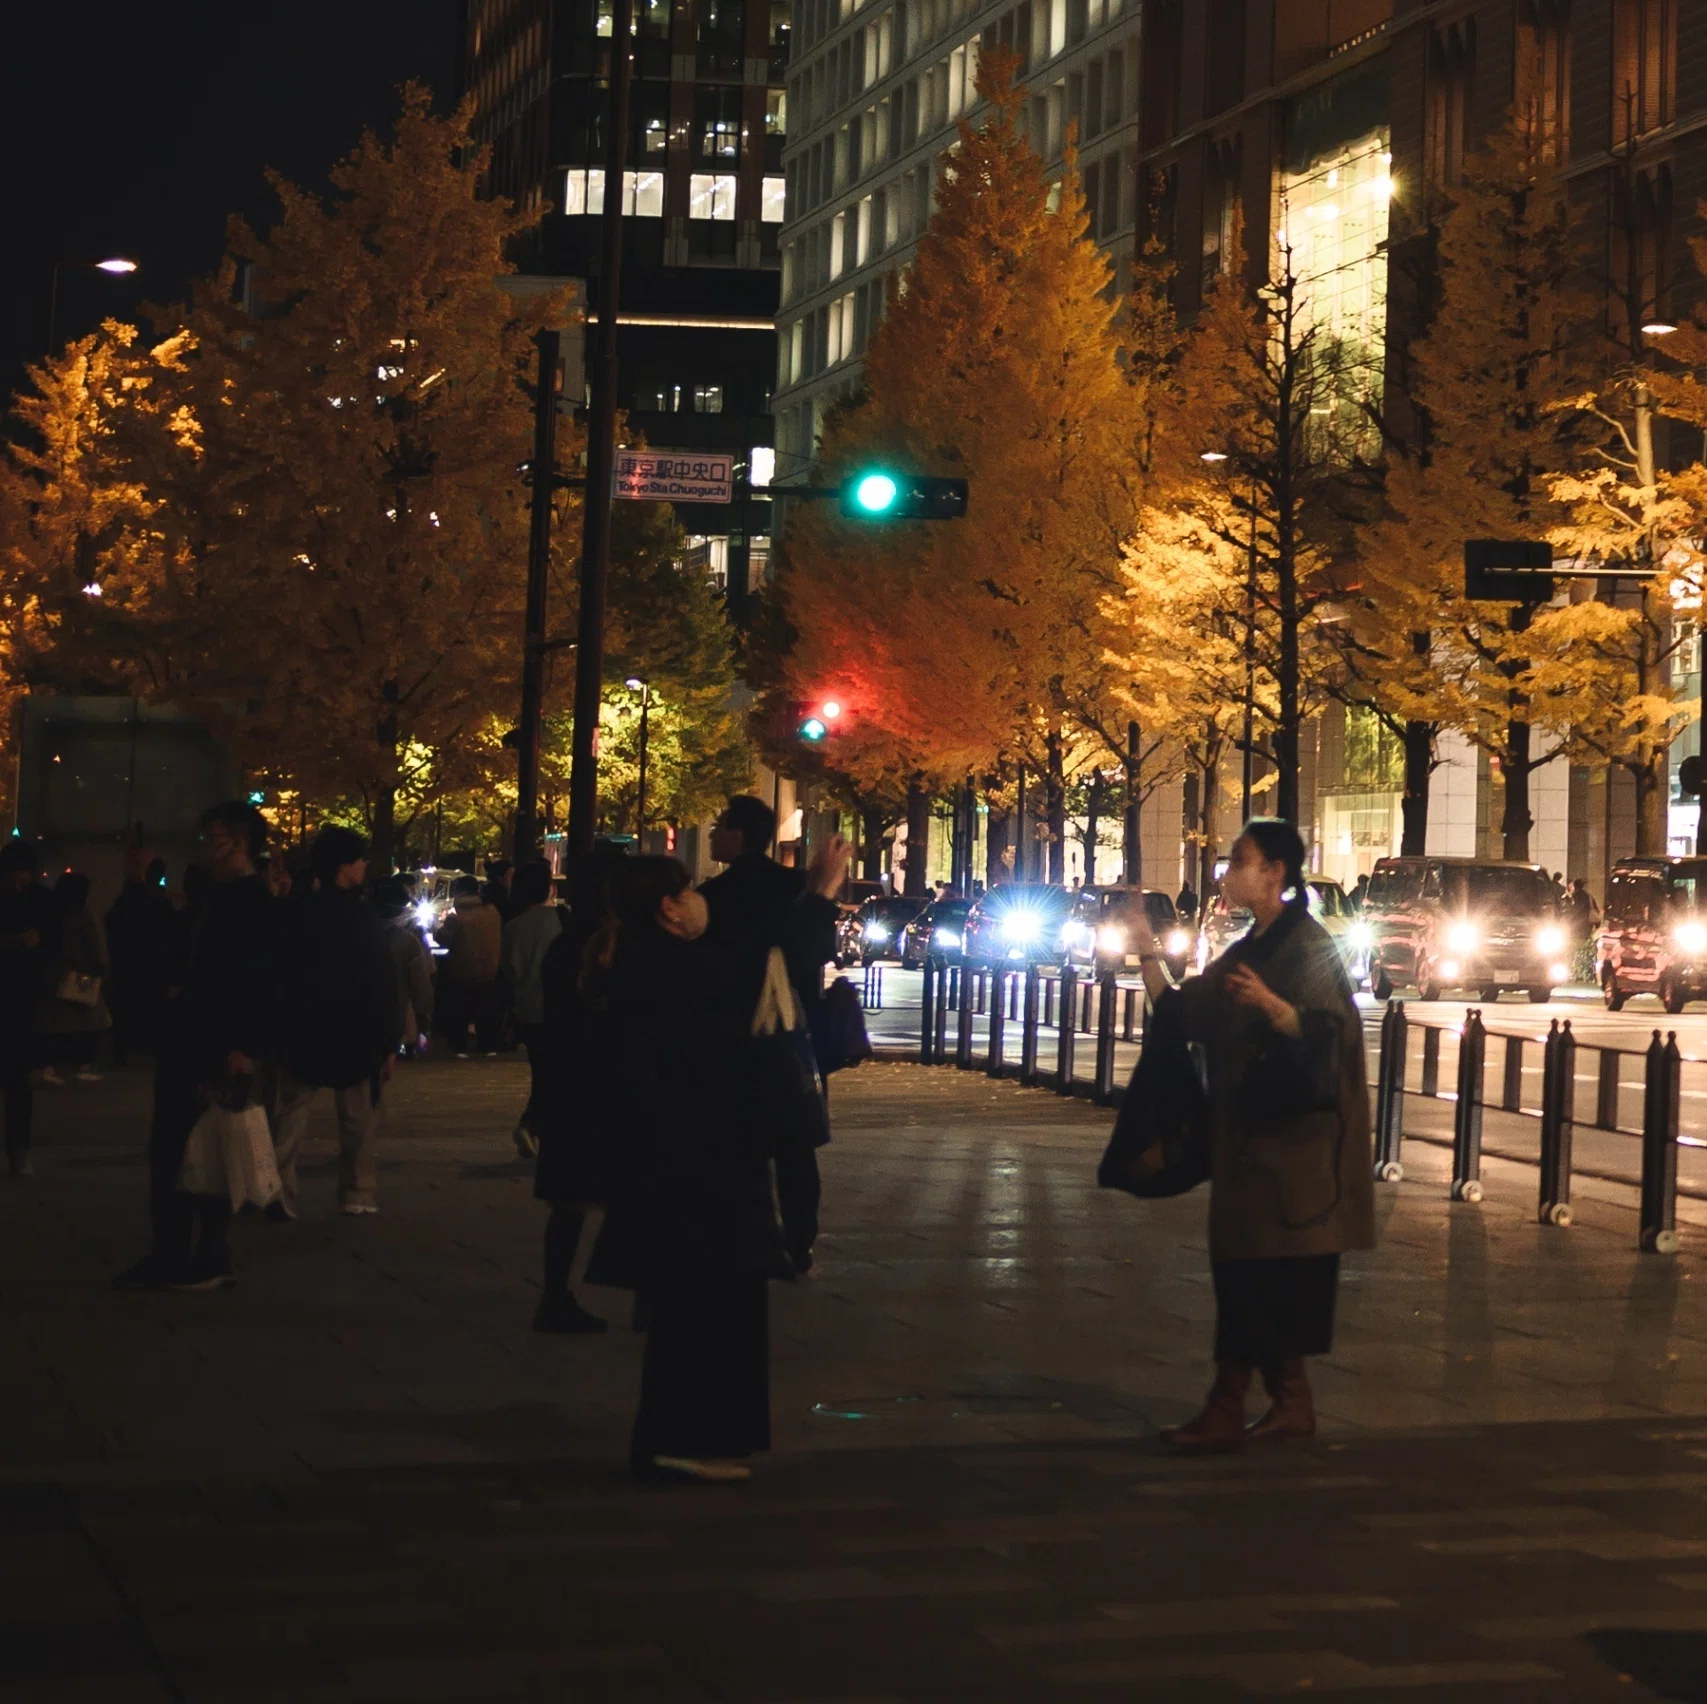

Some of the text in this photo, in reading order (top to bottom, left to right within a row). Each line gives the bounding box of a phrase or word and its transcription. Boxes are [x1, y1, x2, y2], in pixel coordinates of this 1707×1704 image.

[621, 458, 725, 481] 東京駅中央口
[619, 481, 649, 494] Tokyo
[669, 483, 726, 497] Chuoguchi
